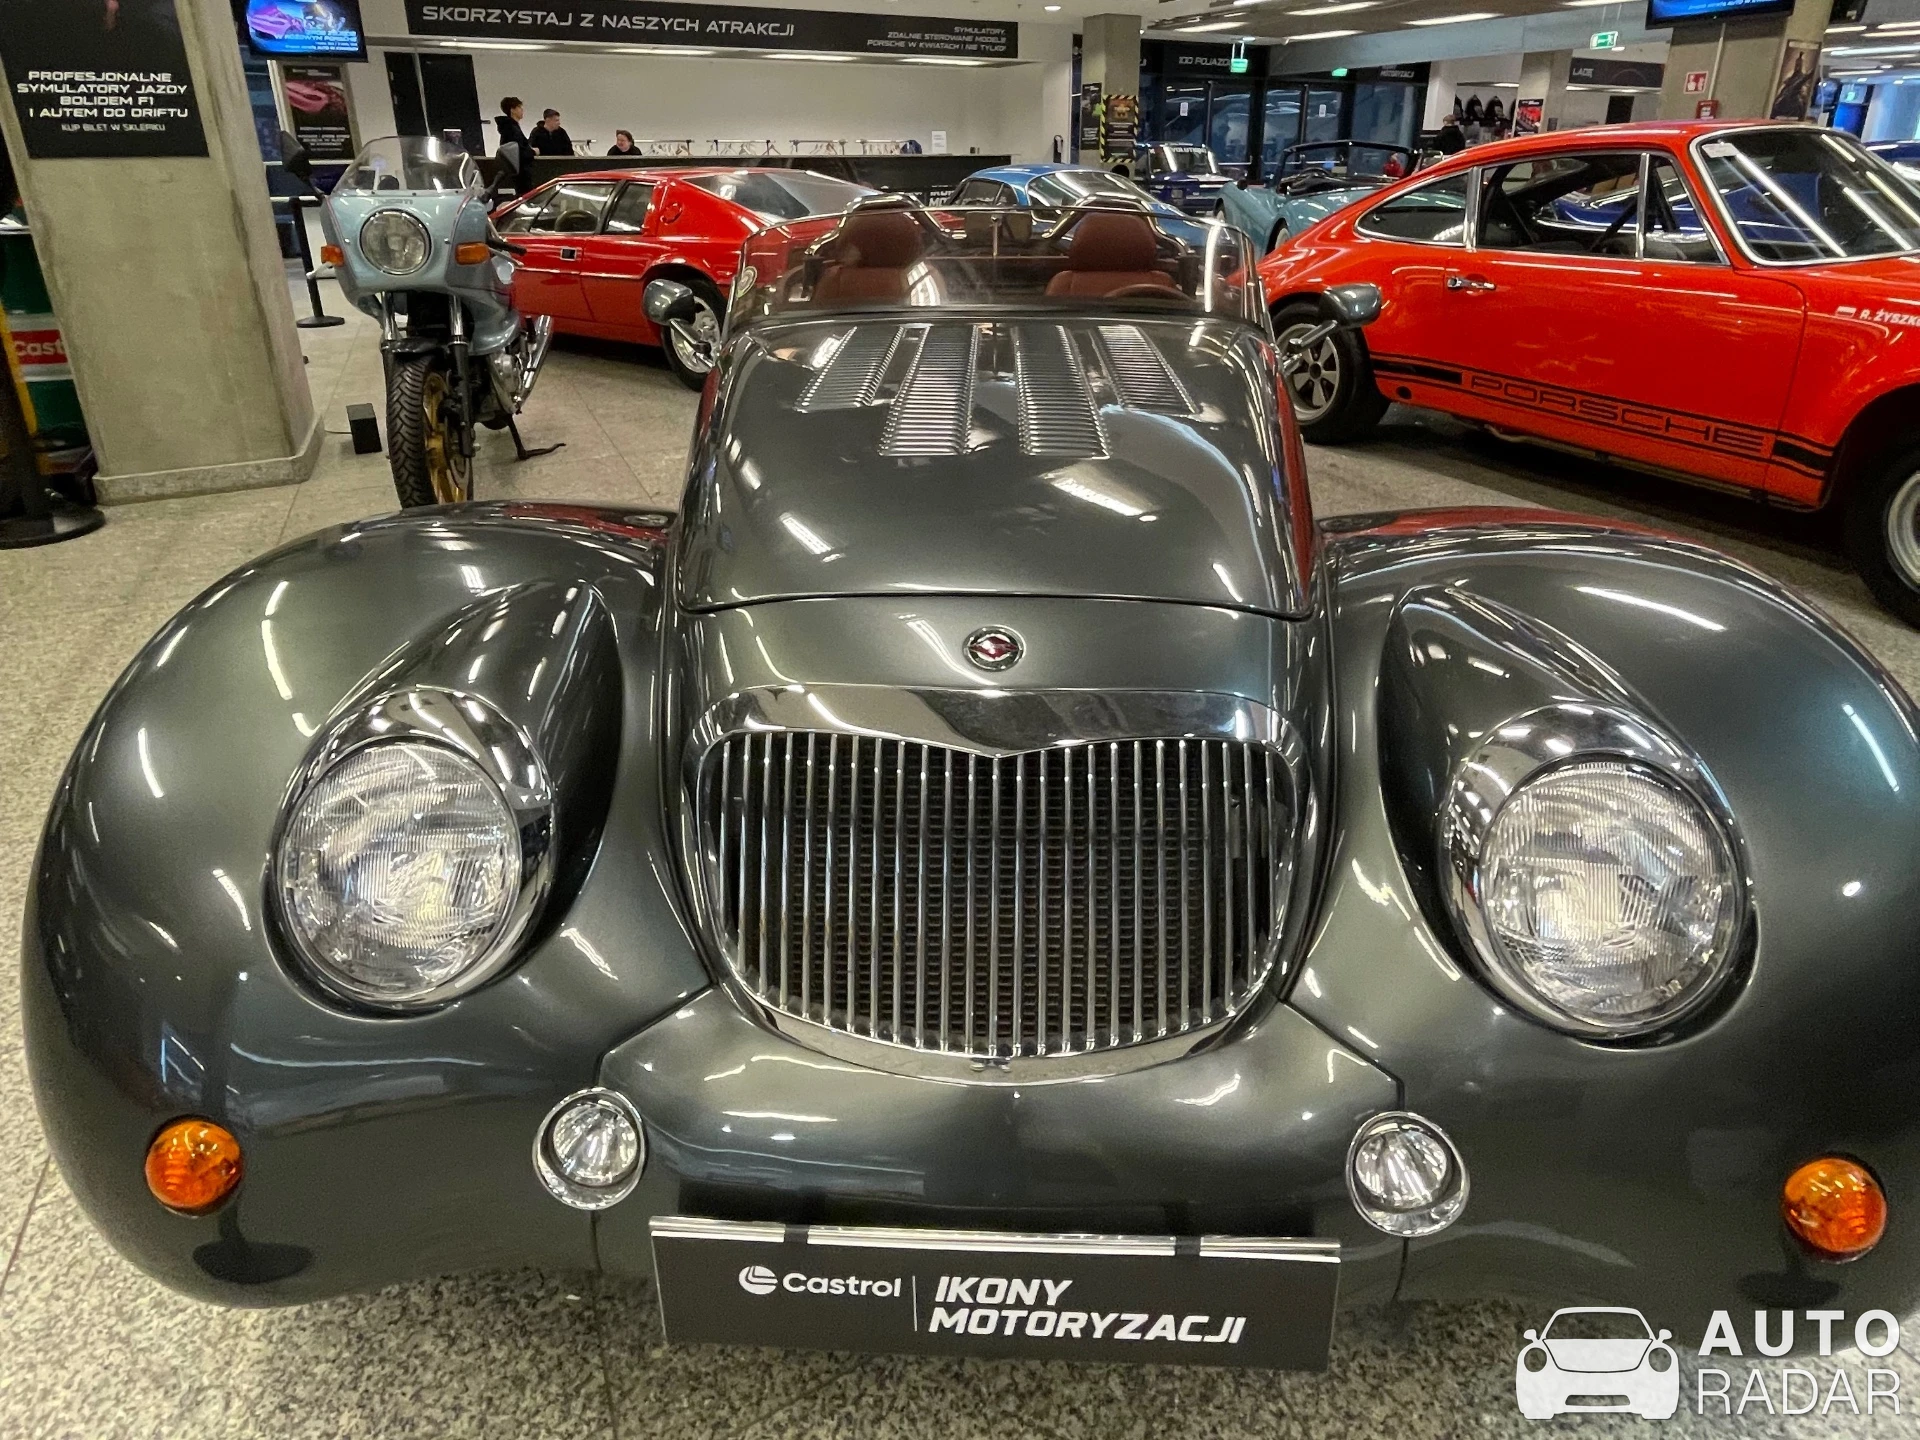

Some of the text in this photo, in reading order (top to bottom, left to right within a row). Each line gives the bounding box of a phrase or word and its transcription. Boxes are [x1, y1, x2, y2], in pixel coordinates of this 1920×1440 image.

[422, 5, 795, 36] SKORZYSTAJ Z NASZYCH ATRAKCJI
[28, 71, 172, 82] PROFESJONALNE
[17, 83, 188, 94] SYMULATORY JAZDY
[60, 96, 154, 106] BOLIDEM F1
[29, 107, 188, 118] I AUTEM DO DRIFTU
[83, 123, 107, 132] BILET
[110, 123, 121, 132] W
[1470, 374, 1765, 454] PORSCHE
[782, 1272, 902, 1298] Castrol
[934, 1276, 1073, 1306] IKONY
[928, 1307, 1246, 1344] MOTORYZACJI
